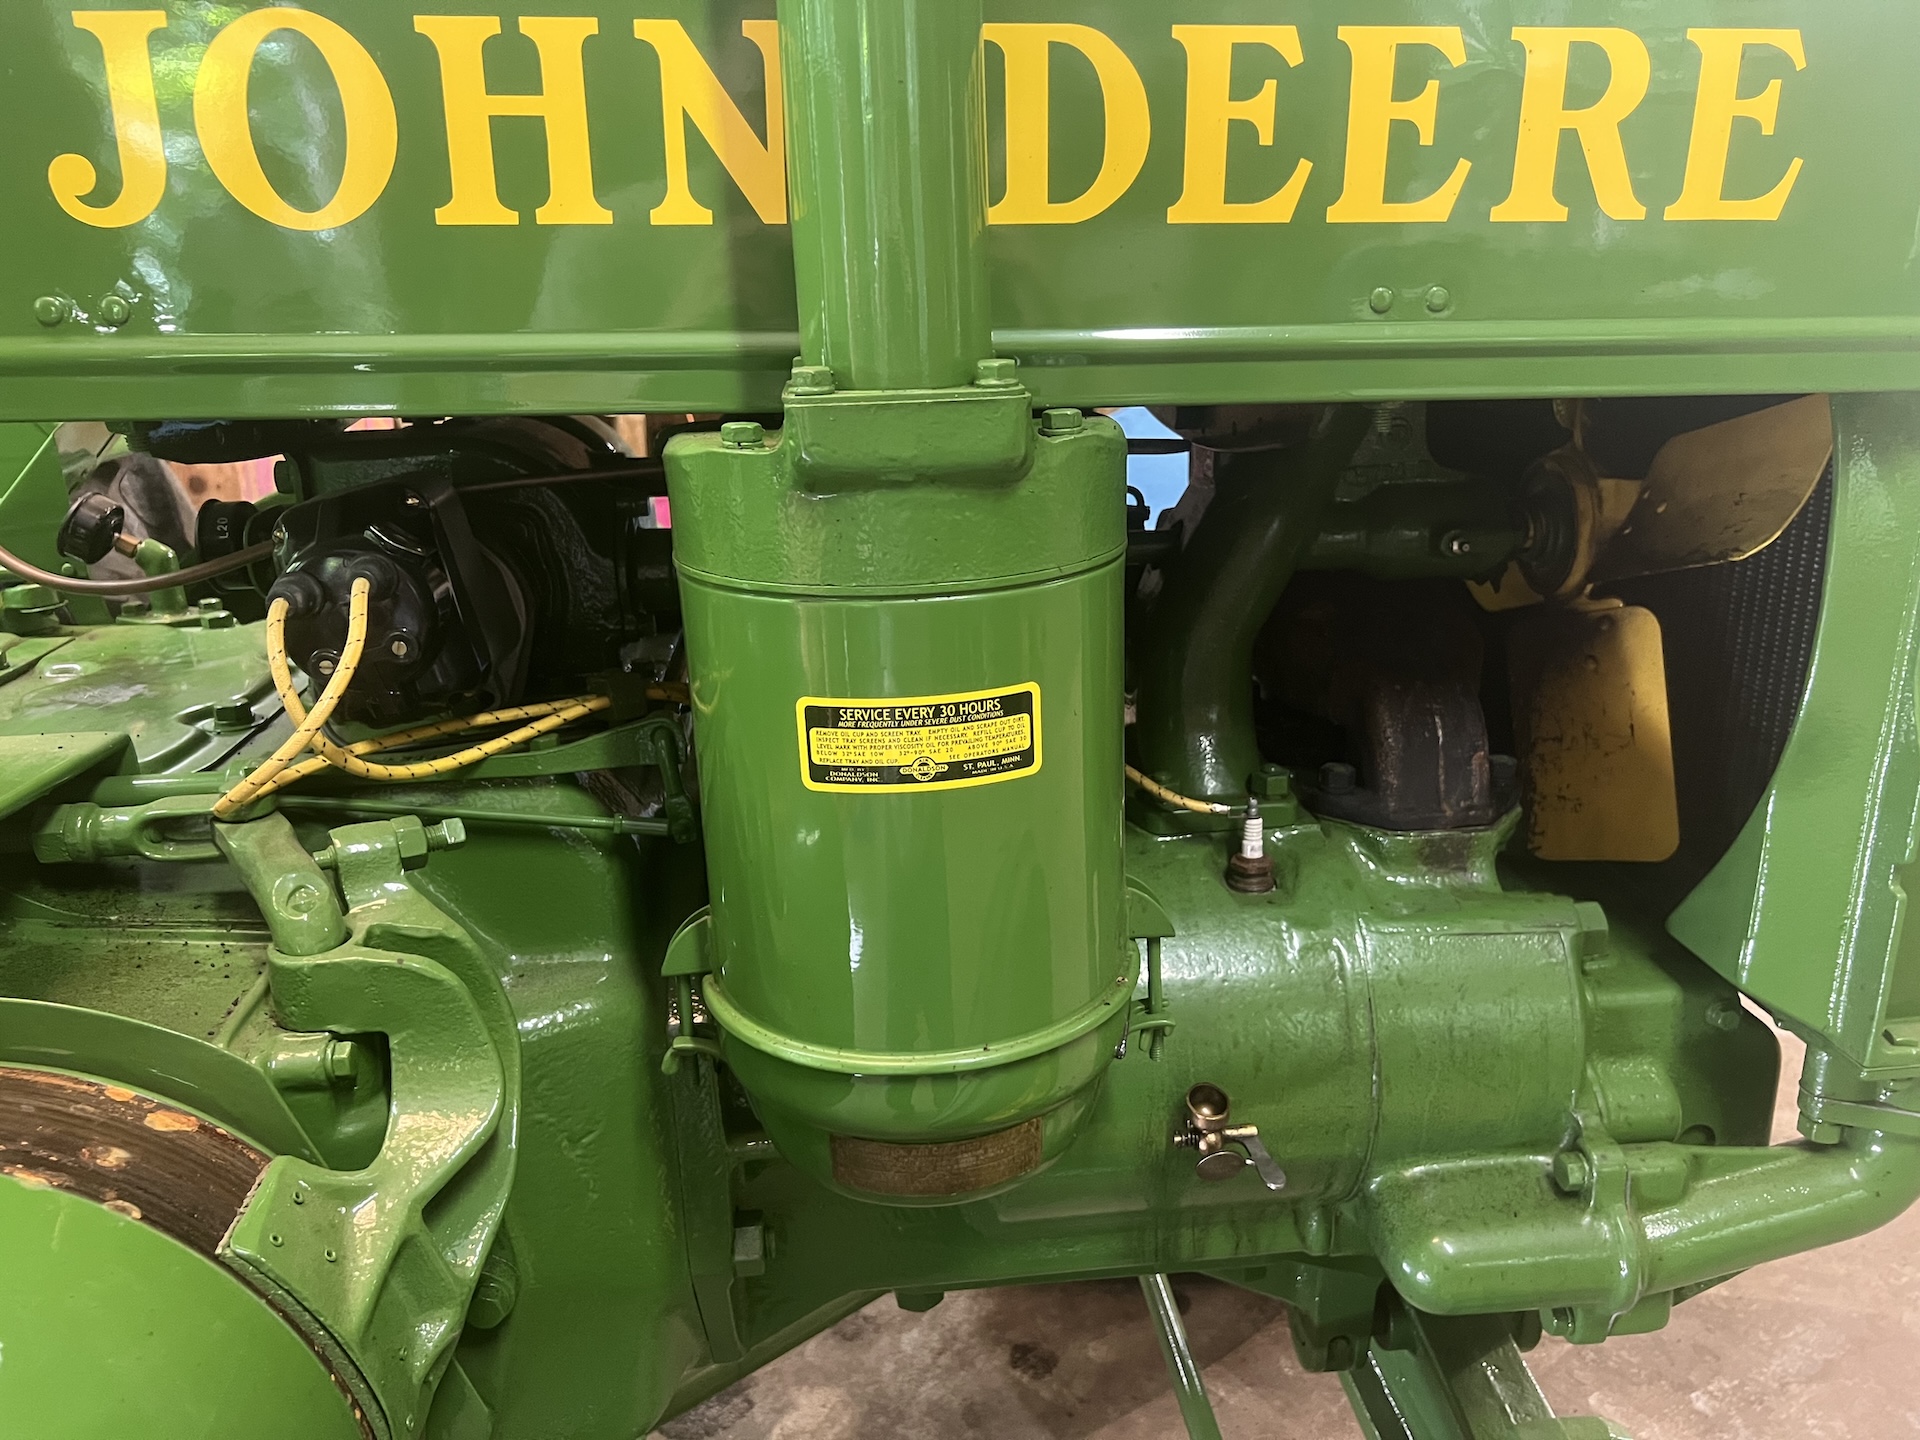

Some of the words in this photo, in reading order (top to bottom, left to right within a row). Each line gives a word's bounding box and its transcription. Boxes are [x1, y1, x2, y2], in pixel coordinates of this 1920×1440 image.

[48, 8, 788, 231] JOHN
[983, 22, 1807, 226] DEERE
[217, 517, 228, 539] L20
[840, 709, 891, 721] SERVICE
[895, 706, 935, 720] EVERY
[940, 705, 955, 717] 30
[960, 699, 1000, 715] HOURS
[838, 720, 856, 728] MORE
[857, 720, 899, 729] FREQUENTLY
[901, 719, 923, 727] UNDER
[924, 717, 948, 725] SEVERE
[949, 715, 966, 723] DUST
[967, 710, 1004, 722] CONDITIONS
[976, 721, 997, 729] SCRAPE
[952, 737, 983, 745] PREVAILING
[964, 748, 998, 758] OPERATORS
[1002, 744, 1025, 752] MANUAL
[963, 763, 974, 771] ST.
